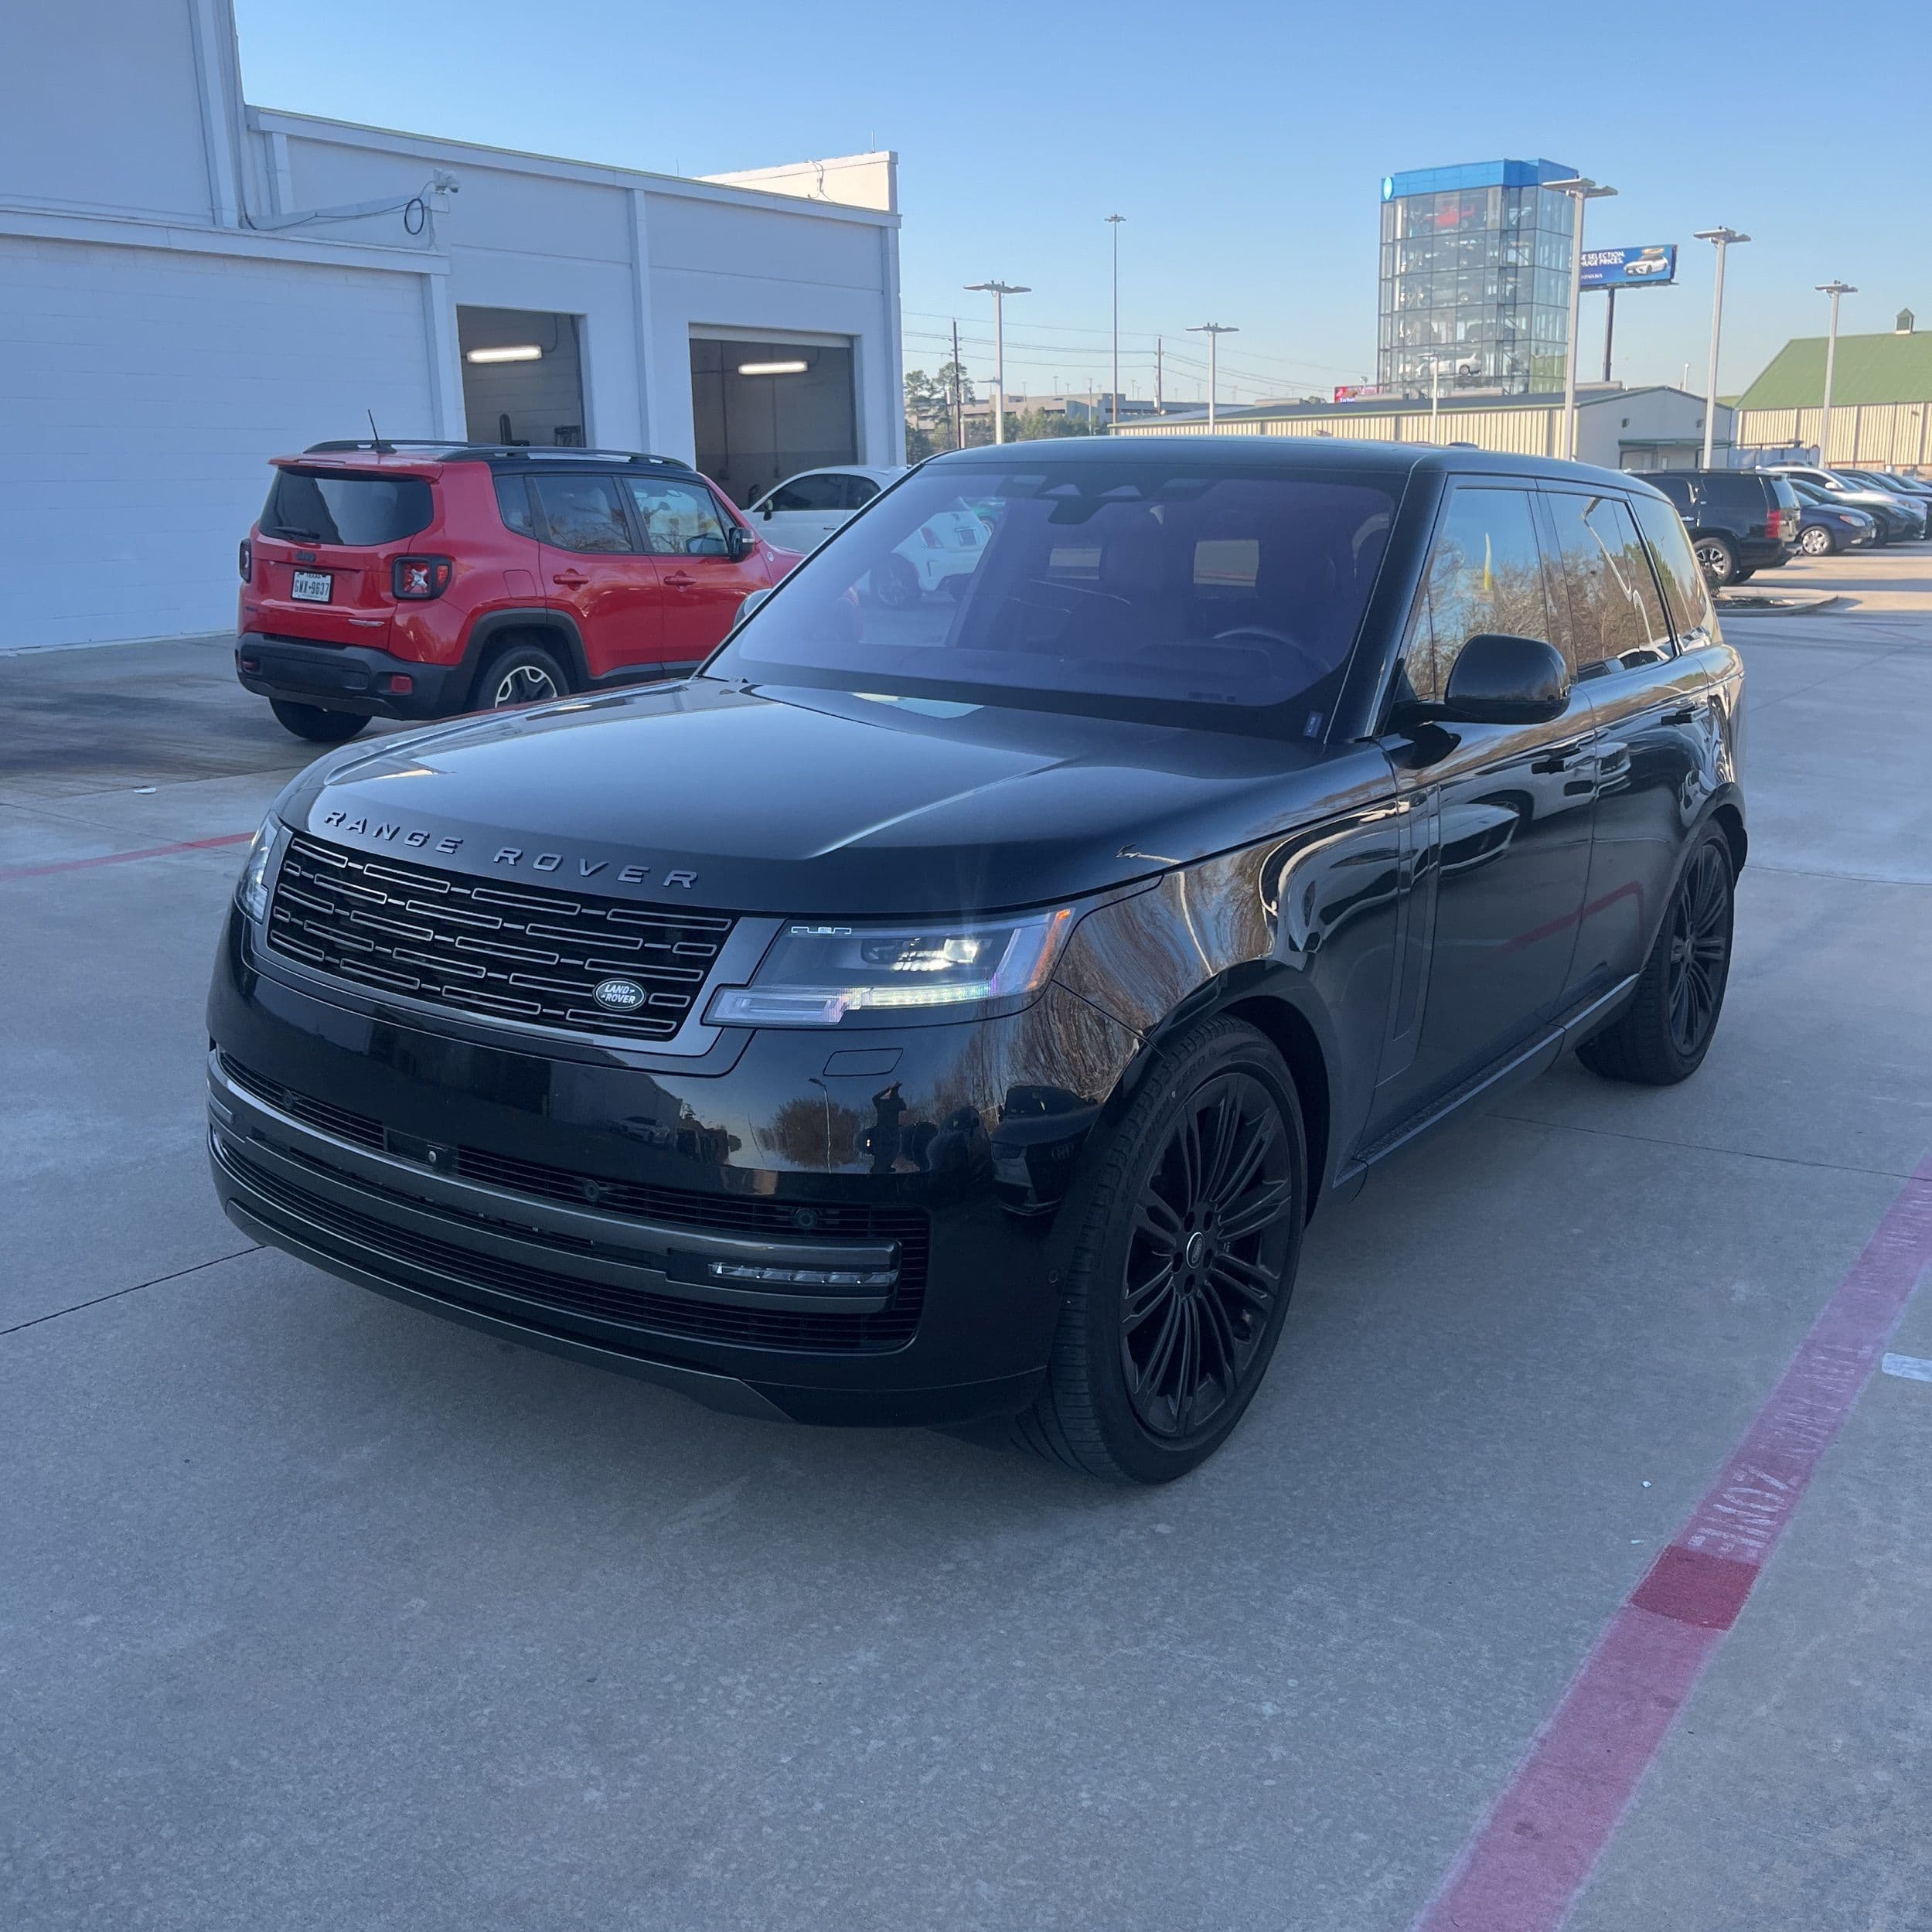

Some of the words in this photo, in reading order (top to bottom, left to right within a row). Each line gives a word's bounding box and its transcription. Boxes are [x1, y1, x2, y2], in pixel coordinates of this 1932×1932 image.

[322, 811, 464, 854] RANGE
[492, 847, 698, 889] ROVER
[605, 985, 630, 993] LAND
[605, 993, 636, 1004] ROVER
